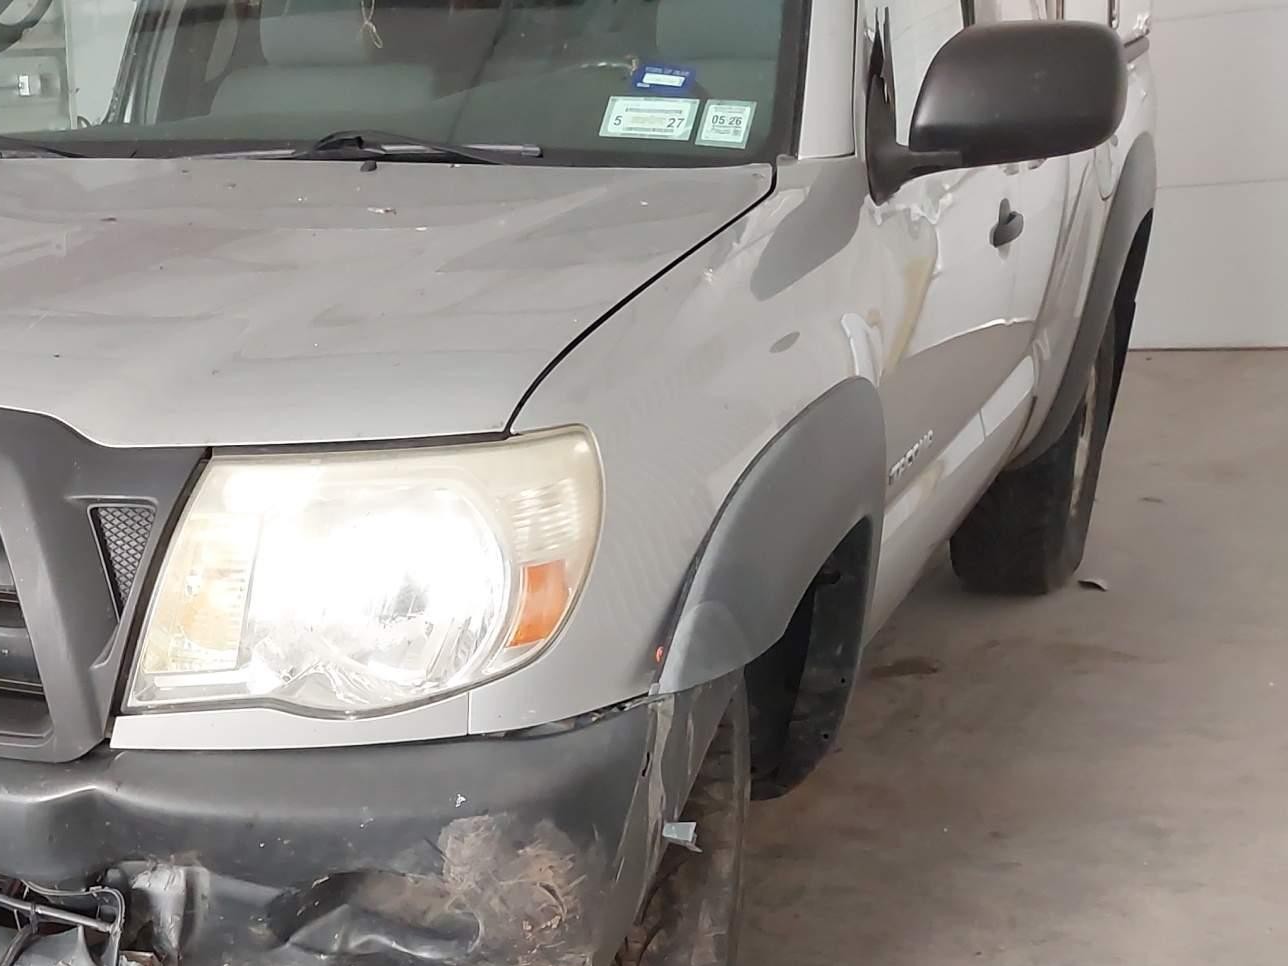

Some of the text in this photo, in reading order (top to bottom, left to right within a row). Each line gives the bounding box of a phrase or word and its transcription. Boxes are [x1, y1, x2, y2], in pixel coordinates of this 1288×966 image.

[613, 115, 685, 128] 5 27
[711, 115, 742, 126] 05 26
